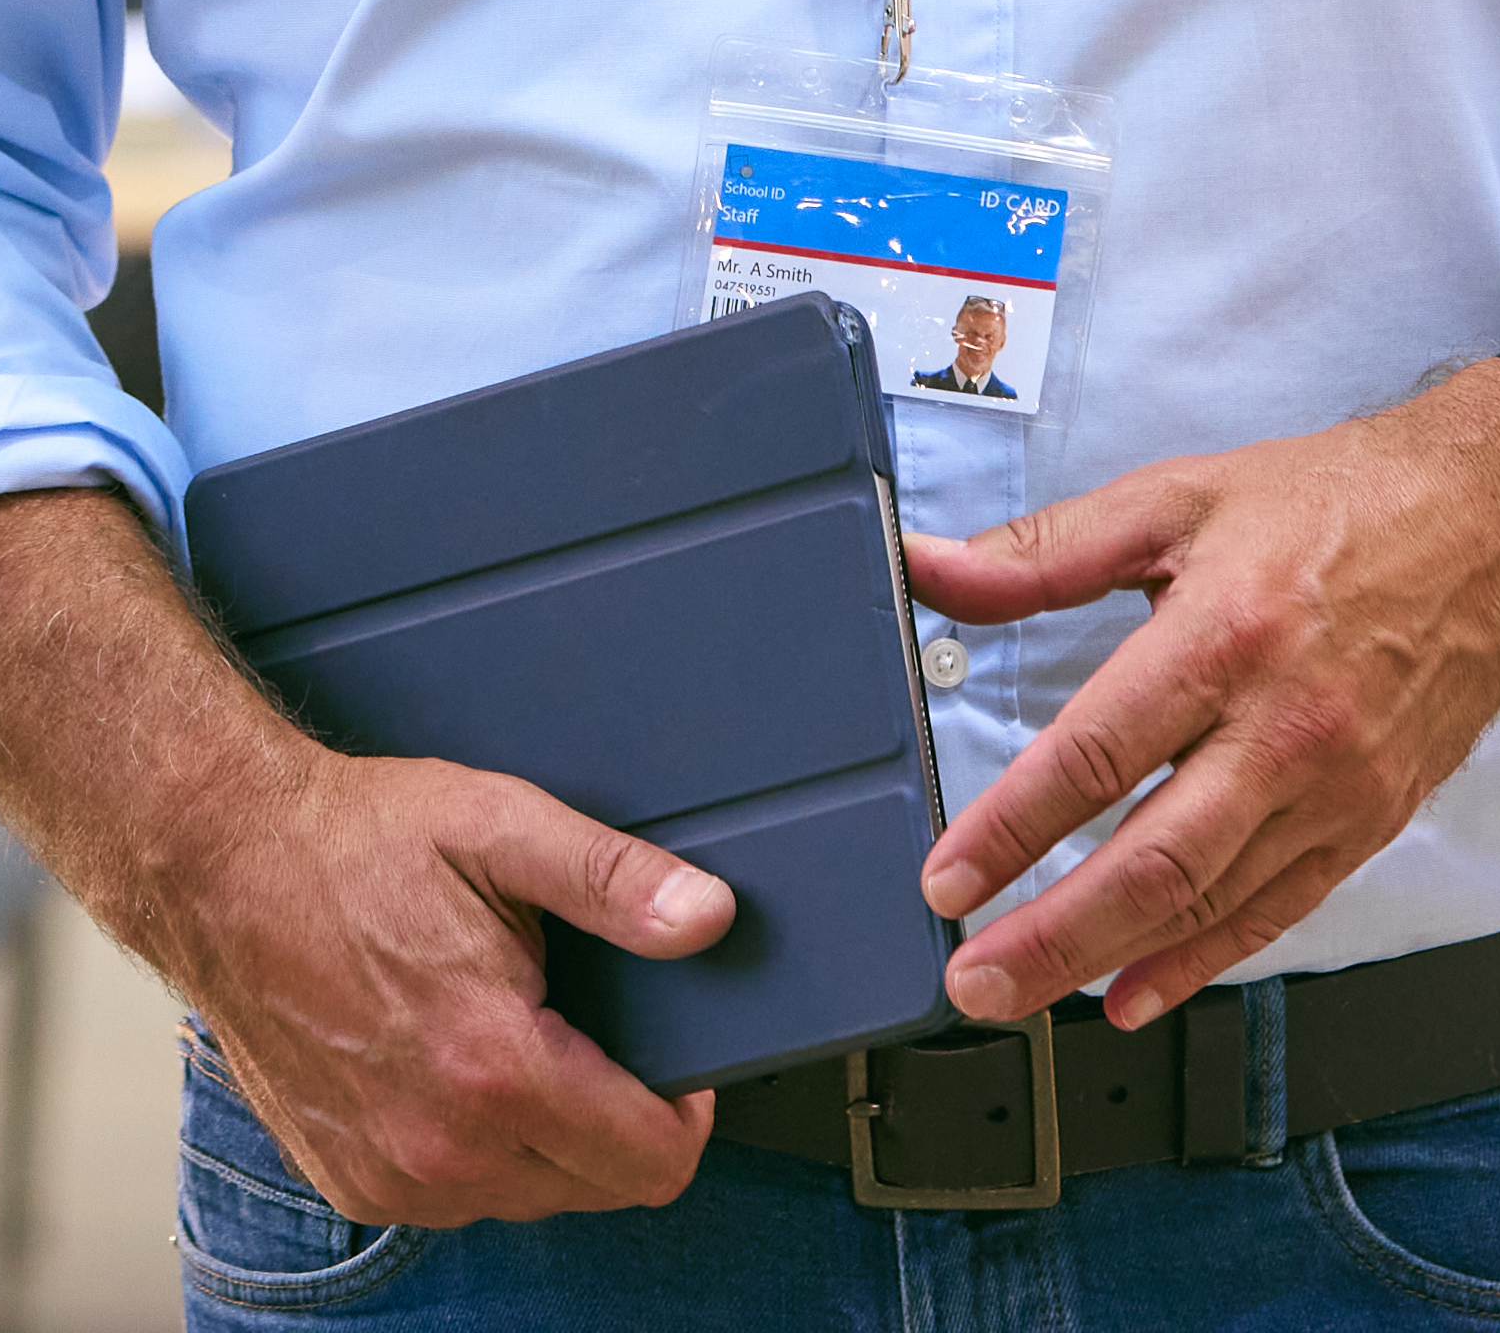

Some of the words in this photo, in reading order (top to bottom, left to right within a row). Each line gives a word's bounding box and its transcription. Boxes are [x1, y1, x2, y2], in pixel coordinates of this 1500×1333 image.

[724, 181, 768, 198] School
[771, 187, 786, 201] ID
[980, 190, 1000, 209] ID
[1006, 194, 1060, 217] CARD
[721, 205, 760, 225] Staff
[717, 258, 742, 274] Mr.
[749, 262, 762, 277] A
[766, 263, 813, 284] Smith
[714, 279, 776, 298] 047519551
